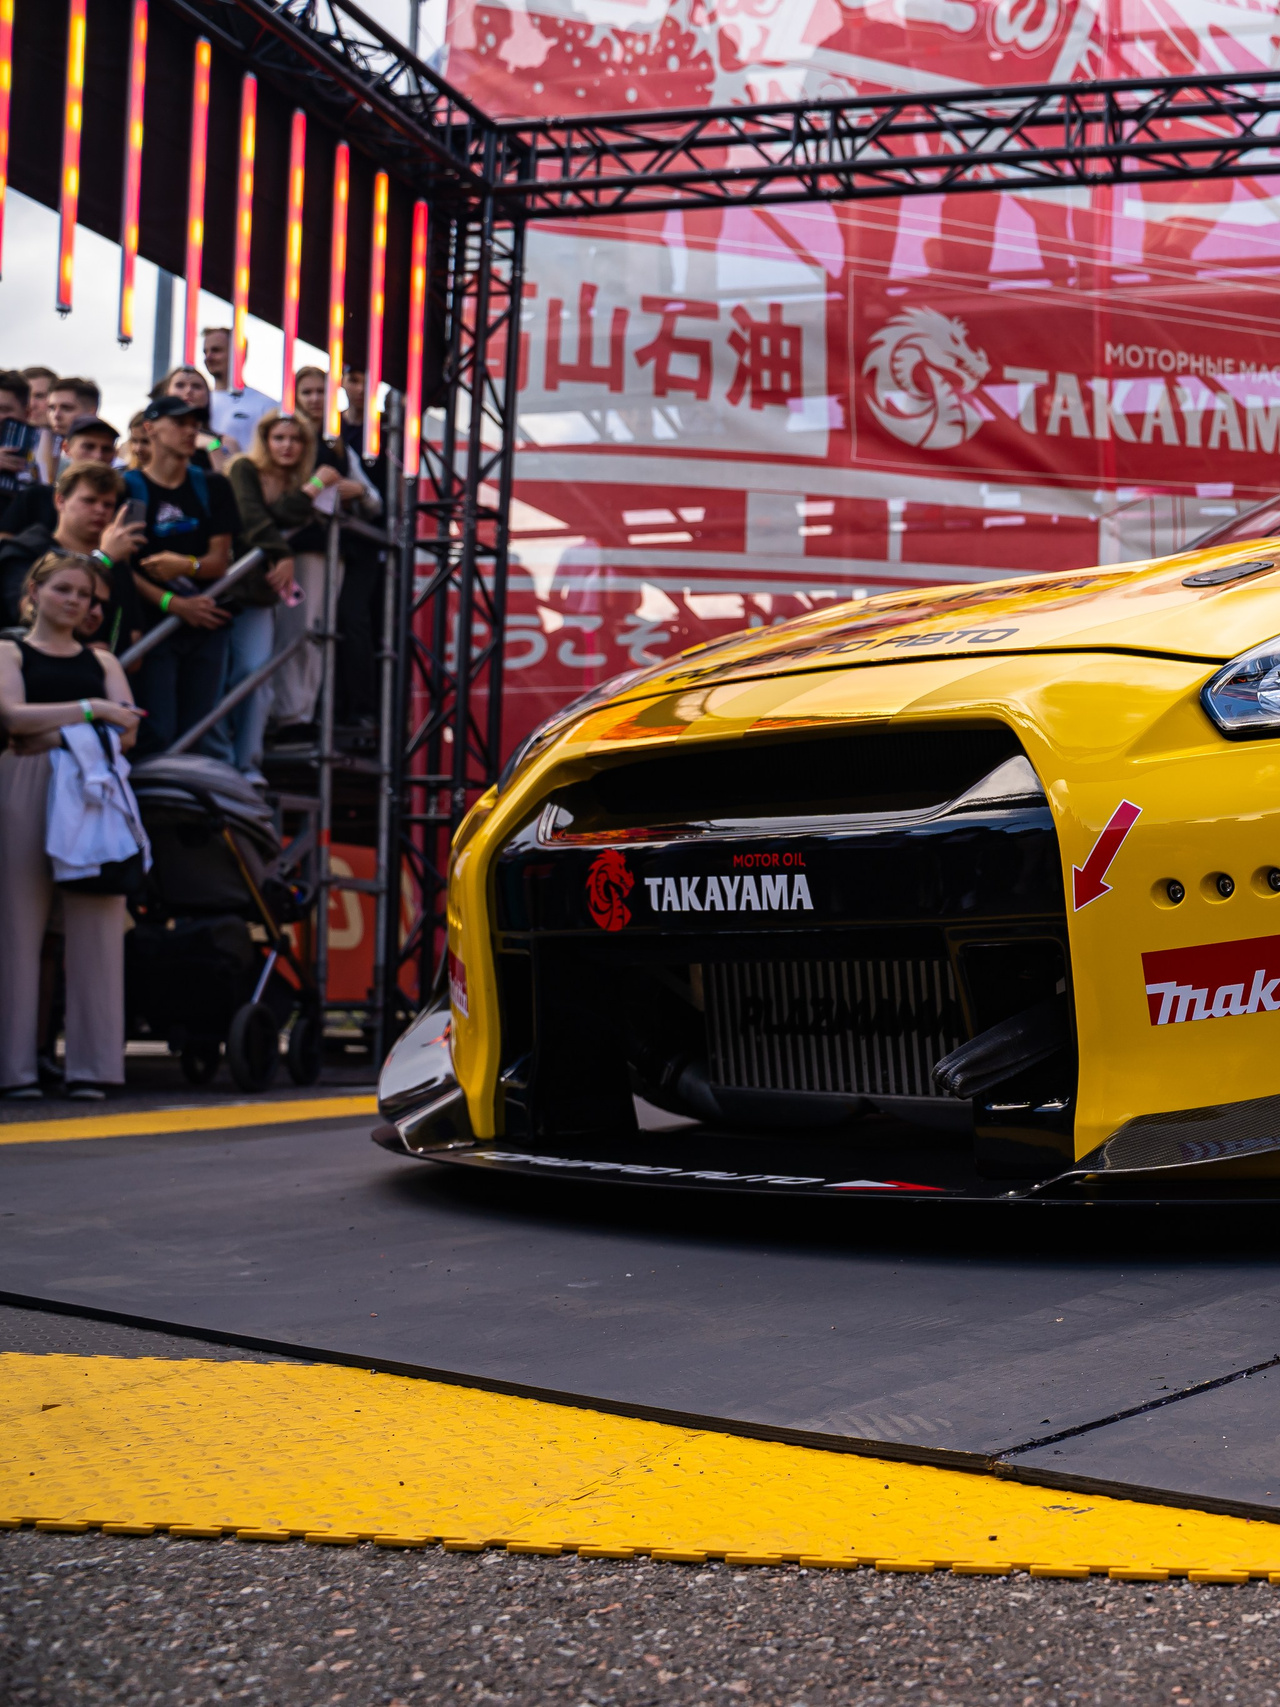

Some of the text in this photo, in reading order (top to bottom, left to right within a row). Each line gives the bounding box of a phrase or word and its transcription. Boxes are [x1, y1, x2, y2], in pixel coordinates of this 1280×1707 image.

[1104, 341, 1236, 381] МОТОРНЫЕ
[733, 852, 806, 868] MOTOR OIL
[644, 873, 814, 912] TAKAYAMA
[670, 1170, 825, 1185] AUTO
